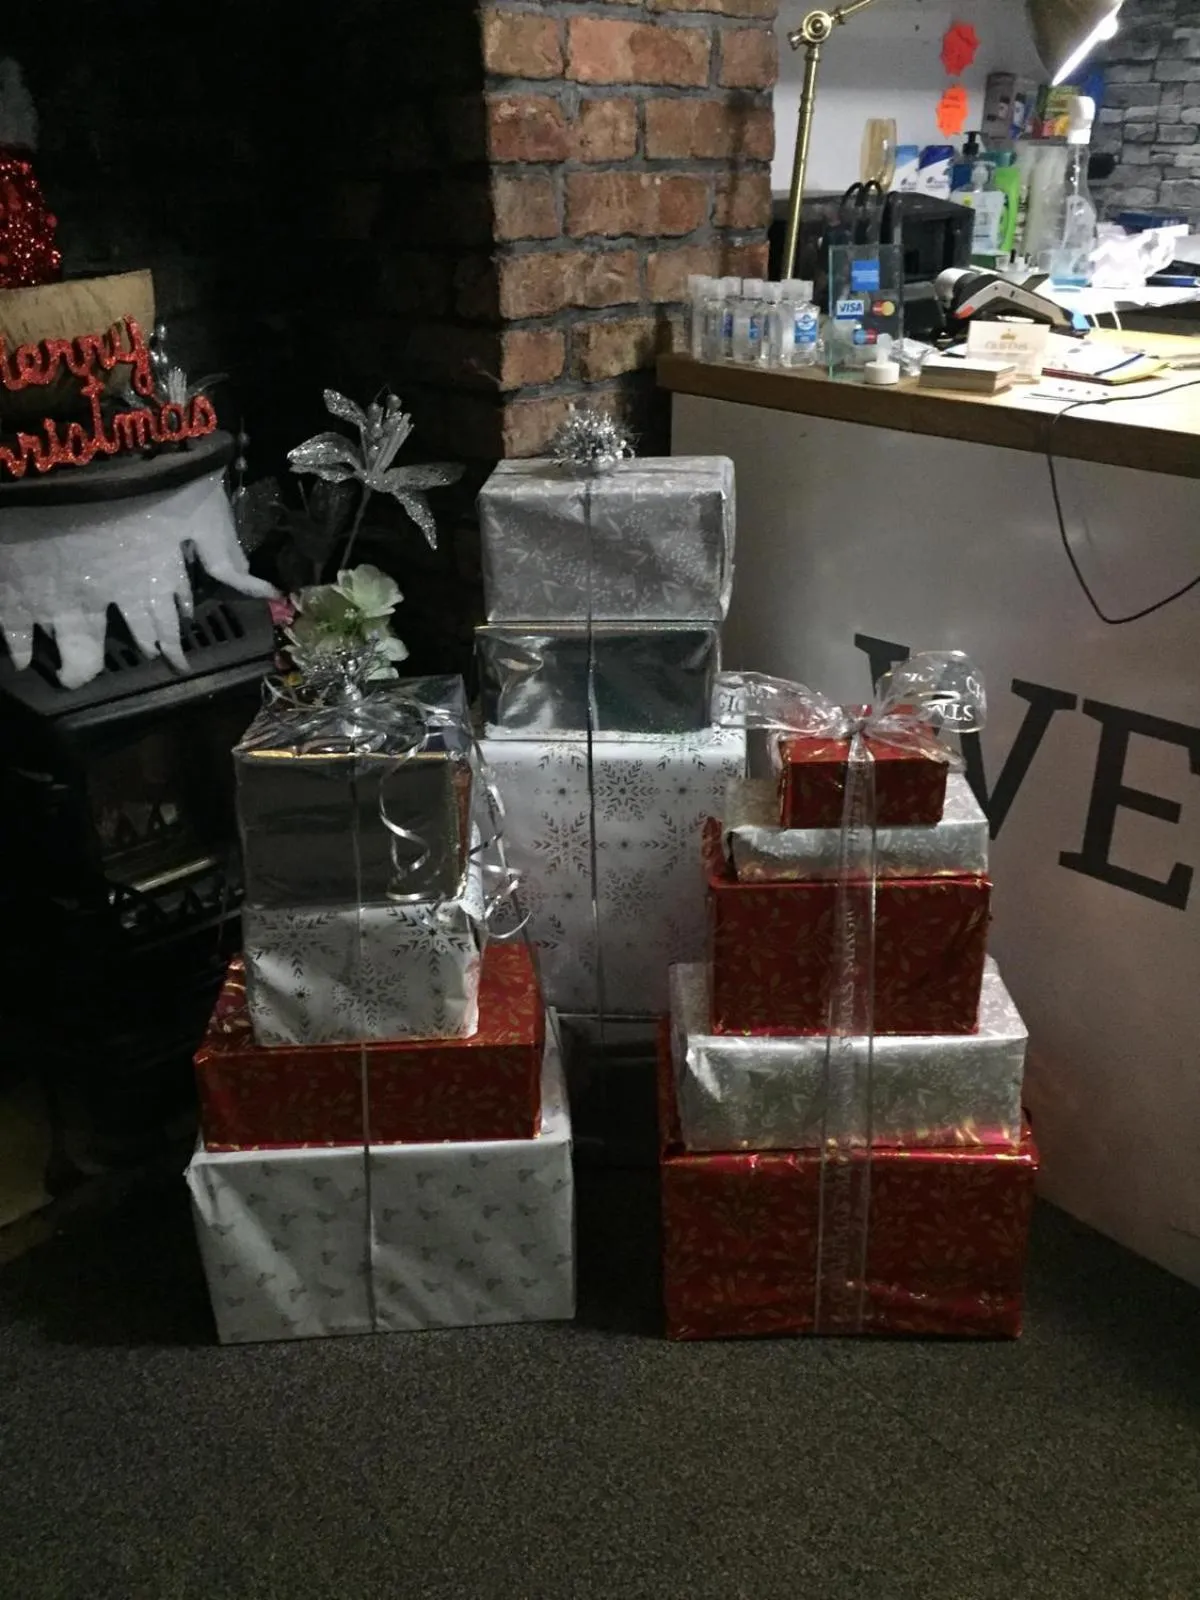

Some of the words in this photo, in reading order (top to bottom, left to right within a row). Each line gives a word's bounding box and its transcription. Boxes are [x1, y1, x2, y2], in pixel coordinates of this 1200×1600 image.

[839, 301, 862, 312] VISA
[0, 312, 155, 396] erry
[0, 376, 219, 478] ristmas
